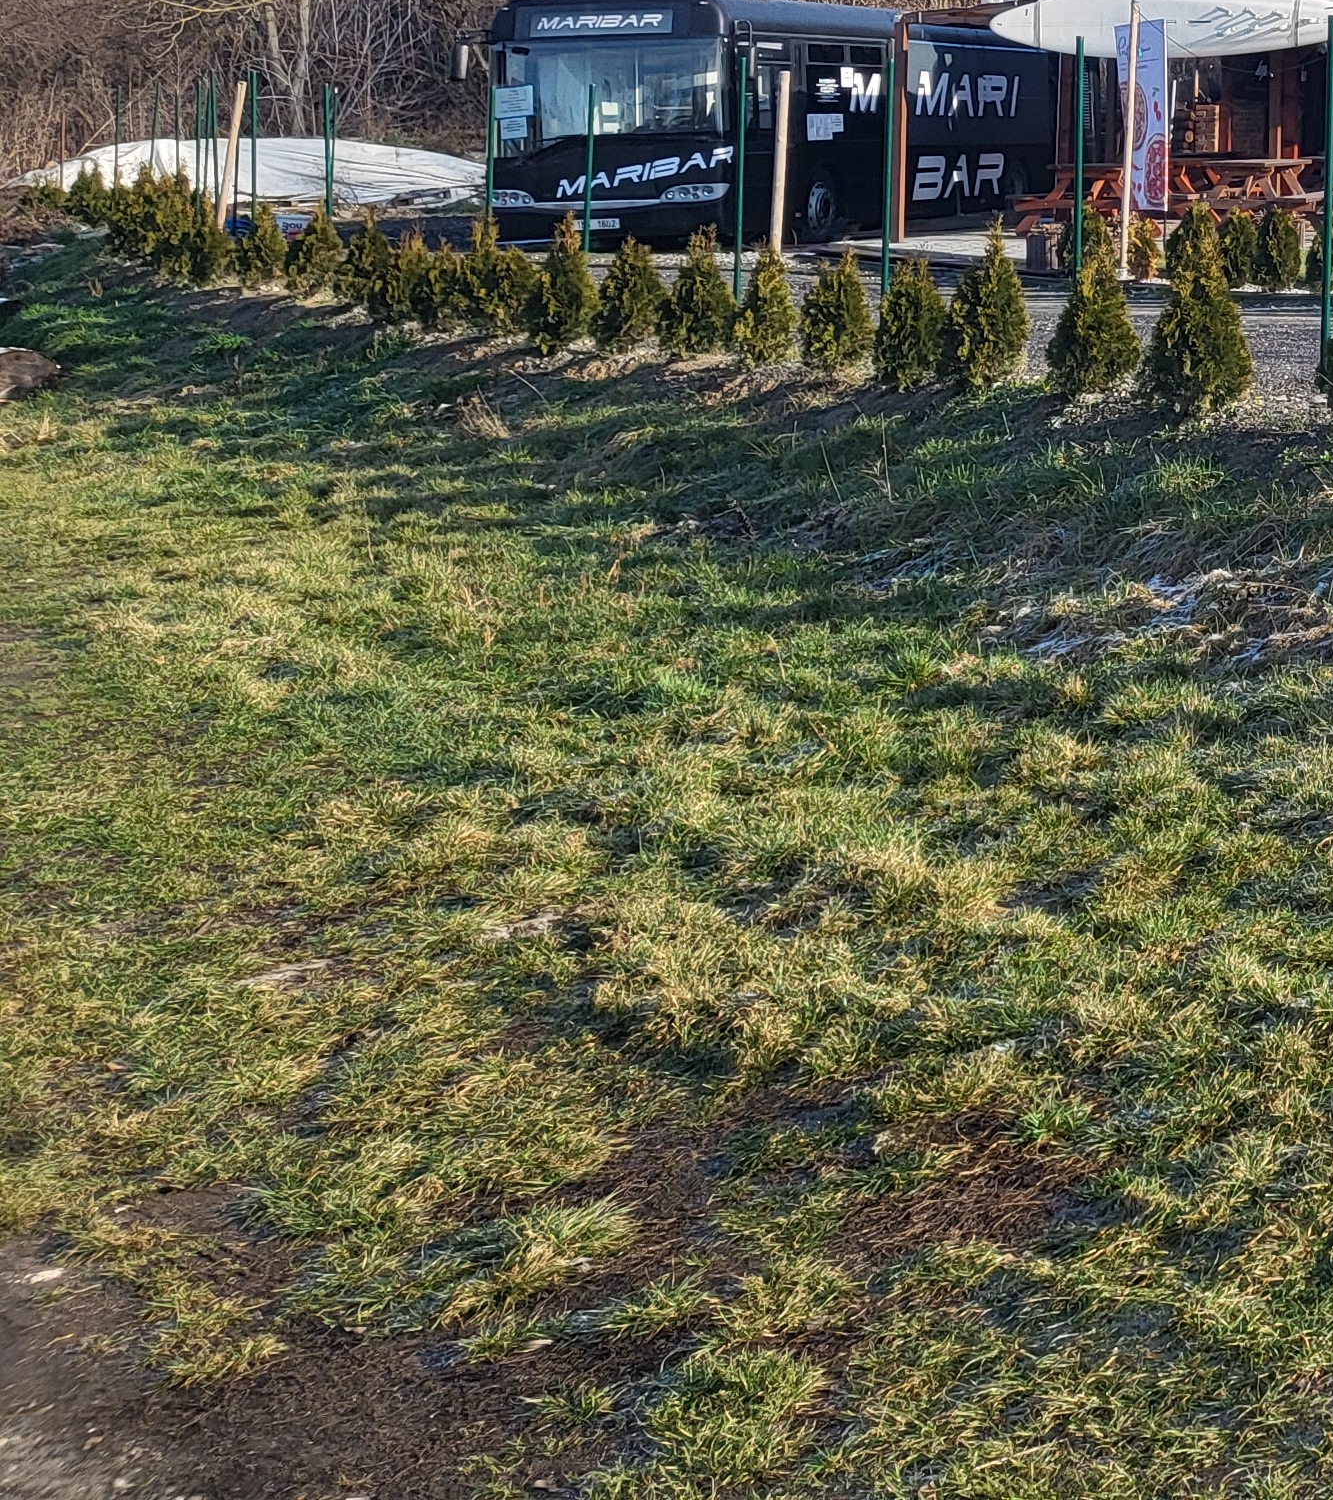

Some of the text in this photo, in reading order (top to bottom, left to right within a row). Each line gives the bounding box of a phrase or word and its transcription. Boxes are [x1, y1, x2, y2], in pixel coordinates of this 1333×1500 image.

[536, 12, 663, 31] MARIBAR
[915, 70, 1020, 117] MARI
[556, 146, 734, 198] MARIBAR
[912, 153, 1004, 201] BAR
